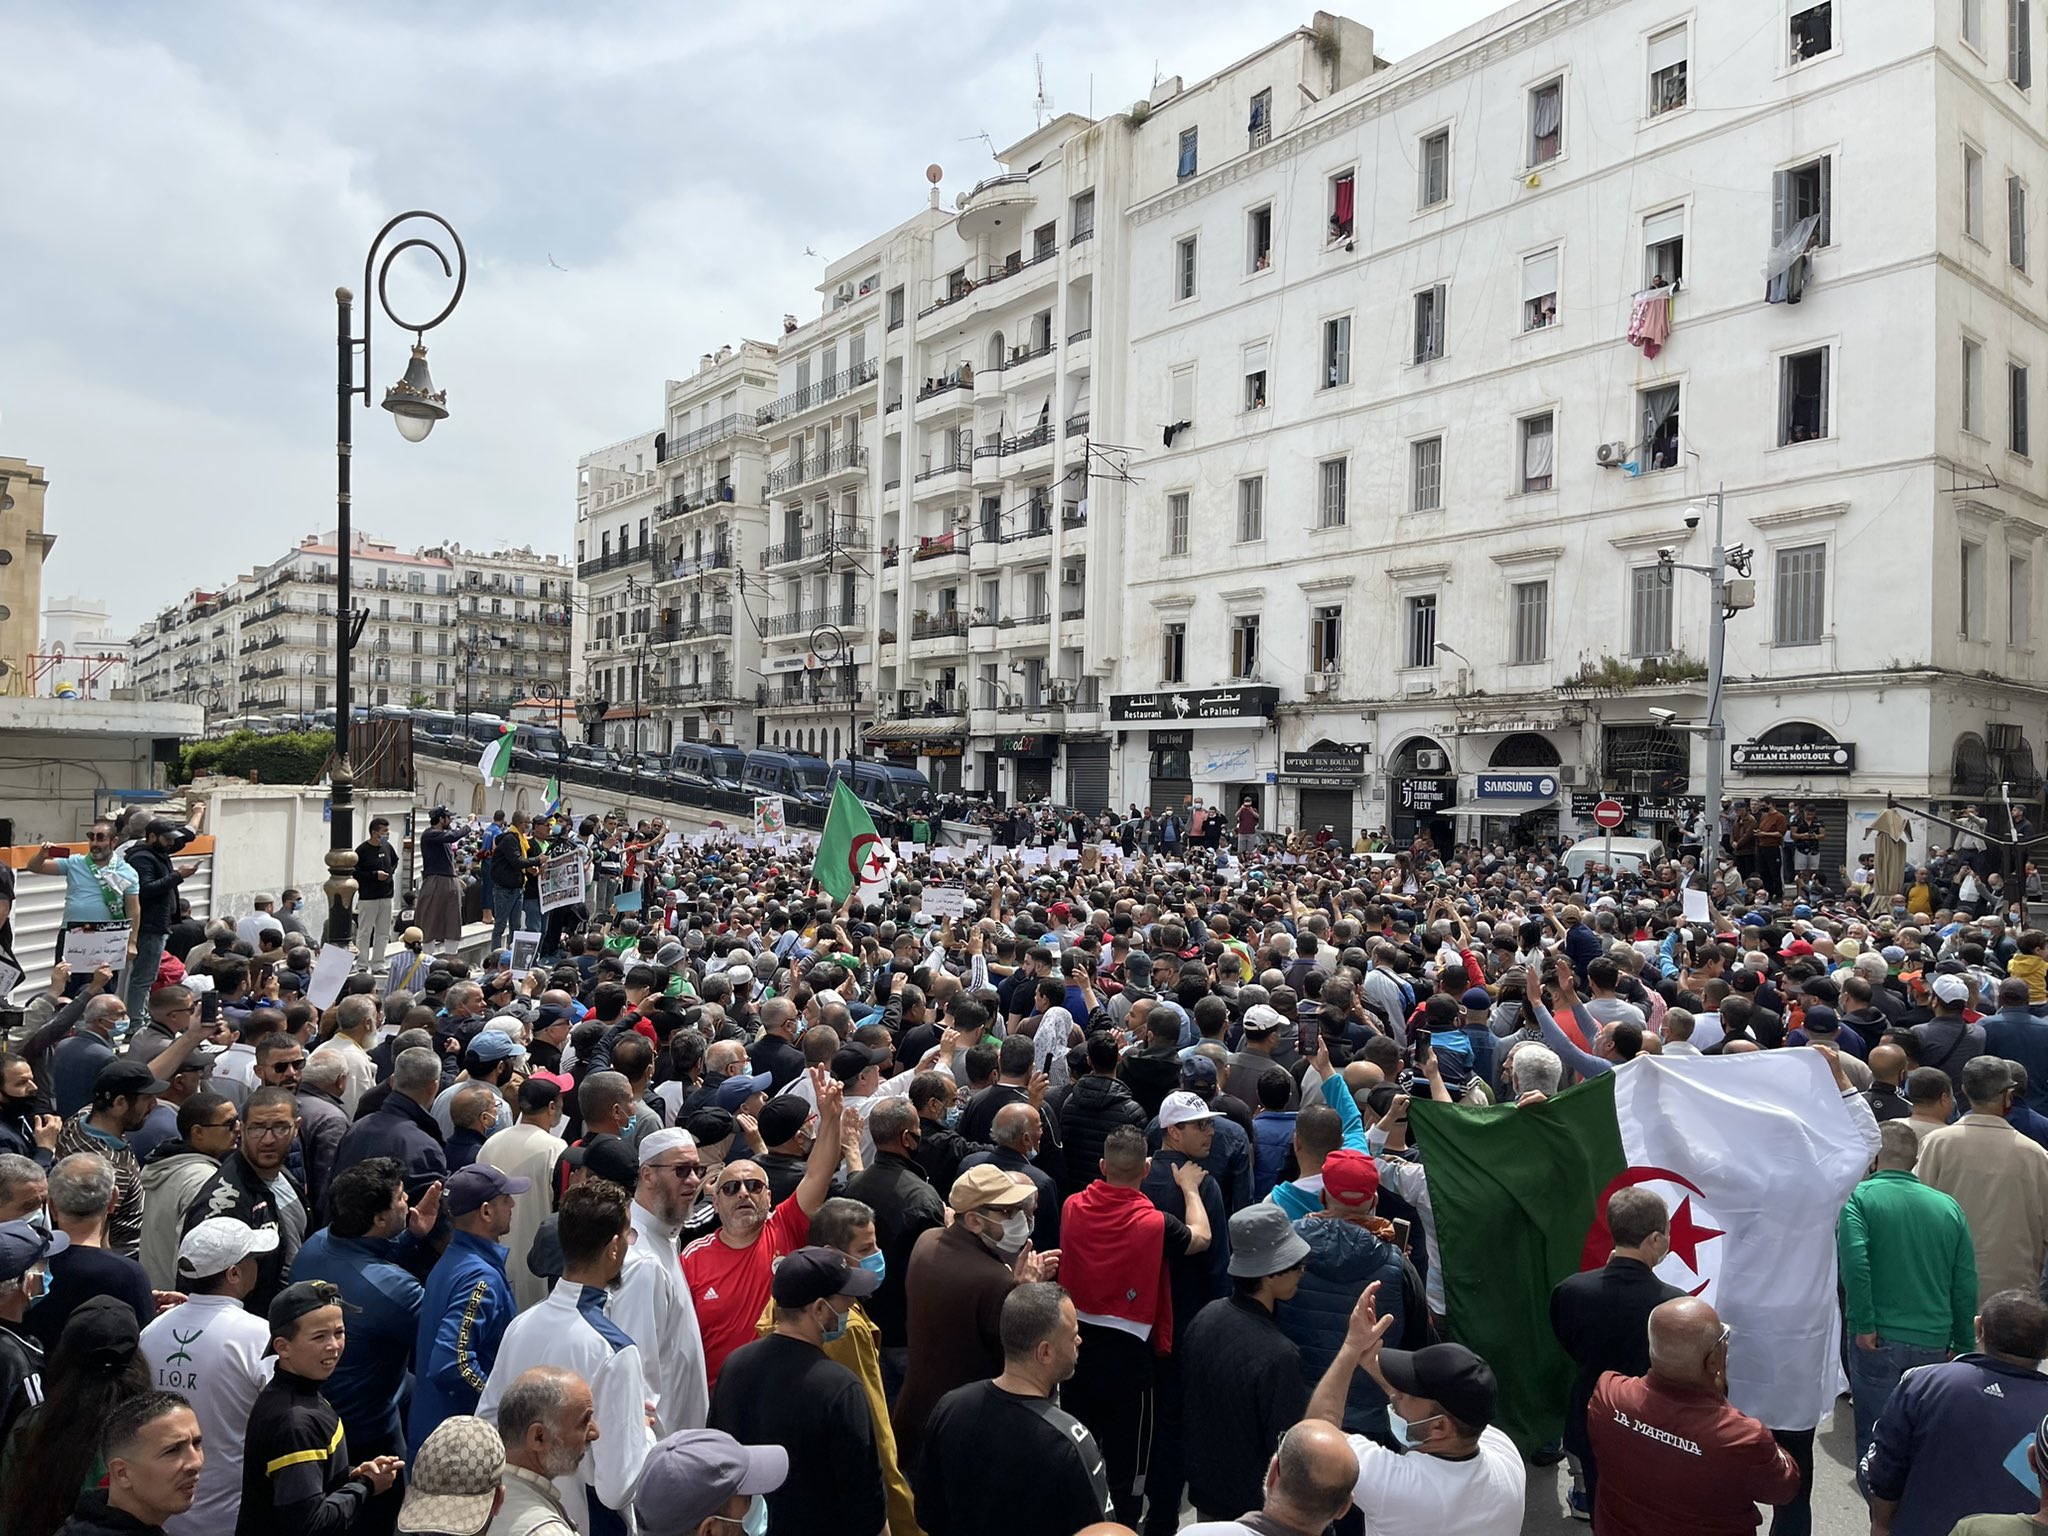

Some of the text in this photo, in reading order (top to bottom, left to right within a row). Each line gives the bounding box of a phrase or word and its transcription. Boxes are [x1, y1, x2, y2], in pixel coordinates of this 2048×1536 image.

[1130, 689, 1240, 706] مطعم النخلة
[1124, 706, 1240, 719] Restaurant Le Palmier
[1156, 734, 1184, 744] Fast Food
[1286, 758, 1359, 767] OPTIQUE BEN BOULAID
[1413, 781, 1437, 791] TABAC
[1484, 781, 1533, 792] SAMSUNG
[1413, 793, 1444, 801] COSMETIQUE
[1413, 801, 1431, 810] FLEXY
[1638, 808, 1674, 819] COIFFEU
[1632, 1419, 1702, 1456] MARTINA
